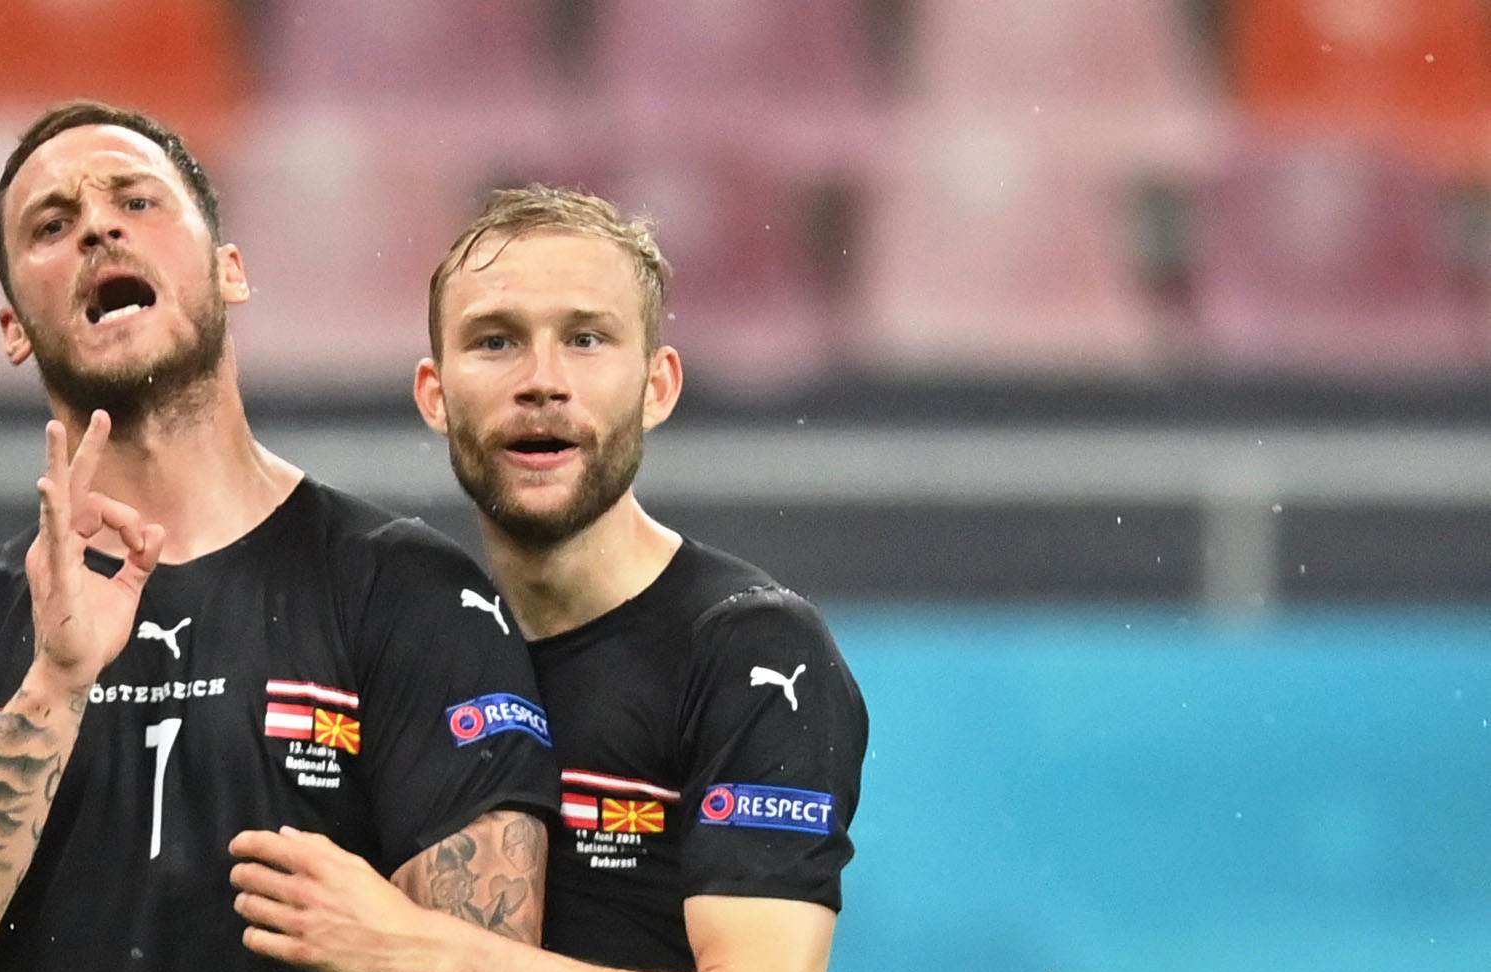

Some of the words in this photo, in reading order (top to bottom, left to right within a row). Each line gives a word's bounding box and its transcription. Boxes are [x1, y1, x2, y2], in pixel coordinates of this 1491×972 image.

[484, 702, 549, 736] RESPECT
[285, 755, 326, 772] National
[297, 772, 340, 788] Bukarest
[736, 795, 832, 823] RESPECT
[616, 833, 642, 845] 2021
[590, 855, 638, 868] Bukarest
